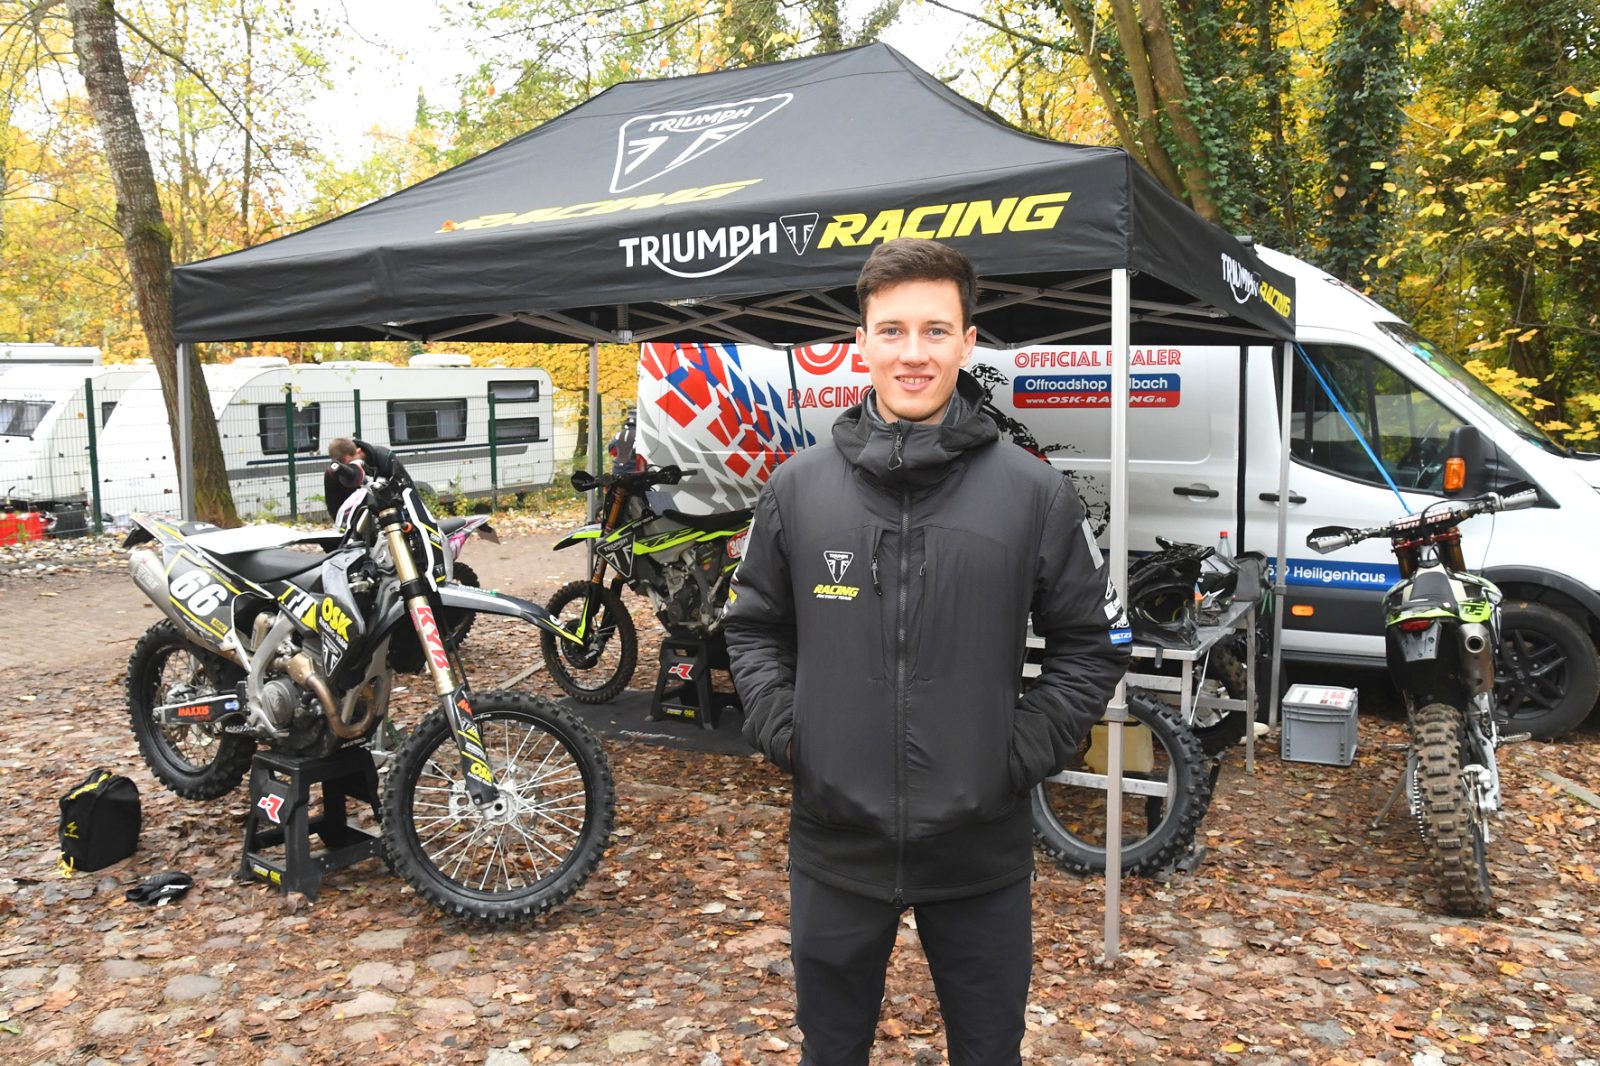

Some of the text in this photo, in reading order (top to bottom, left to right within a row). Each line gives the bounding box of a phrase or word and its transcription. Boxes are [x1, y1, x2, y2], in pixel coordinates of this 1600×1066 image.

[649, 106, 755, 133] TRIUMPH
[435, 178, 764, 233] RACING
[618, 191, 1072, 278] TRIUMPH RACING
[1221, 252, 1292, 318] TRIUMPH RACING
[1014, 349, 1182, 369] OFFICIAL ALER
[1025, 378, 1108, 392] Offroadshop
[1293, 566, 1386, 583] Heiligenhaus
[169, 569, 229, 617] 66
[813, 584, 860, 598] RACING
[321, 597, 353, 642] OSK
[416, 606, 450, 671] KYB
[178, 705, 210, 717] MAXXIS
[470, 762, 493, 784] OSK
